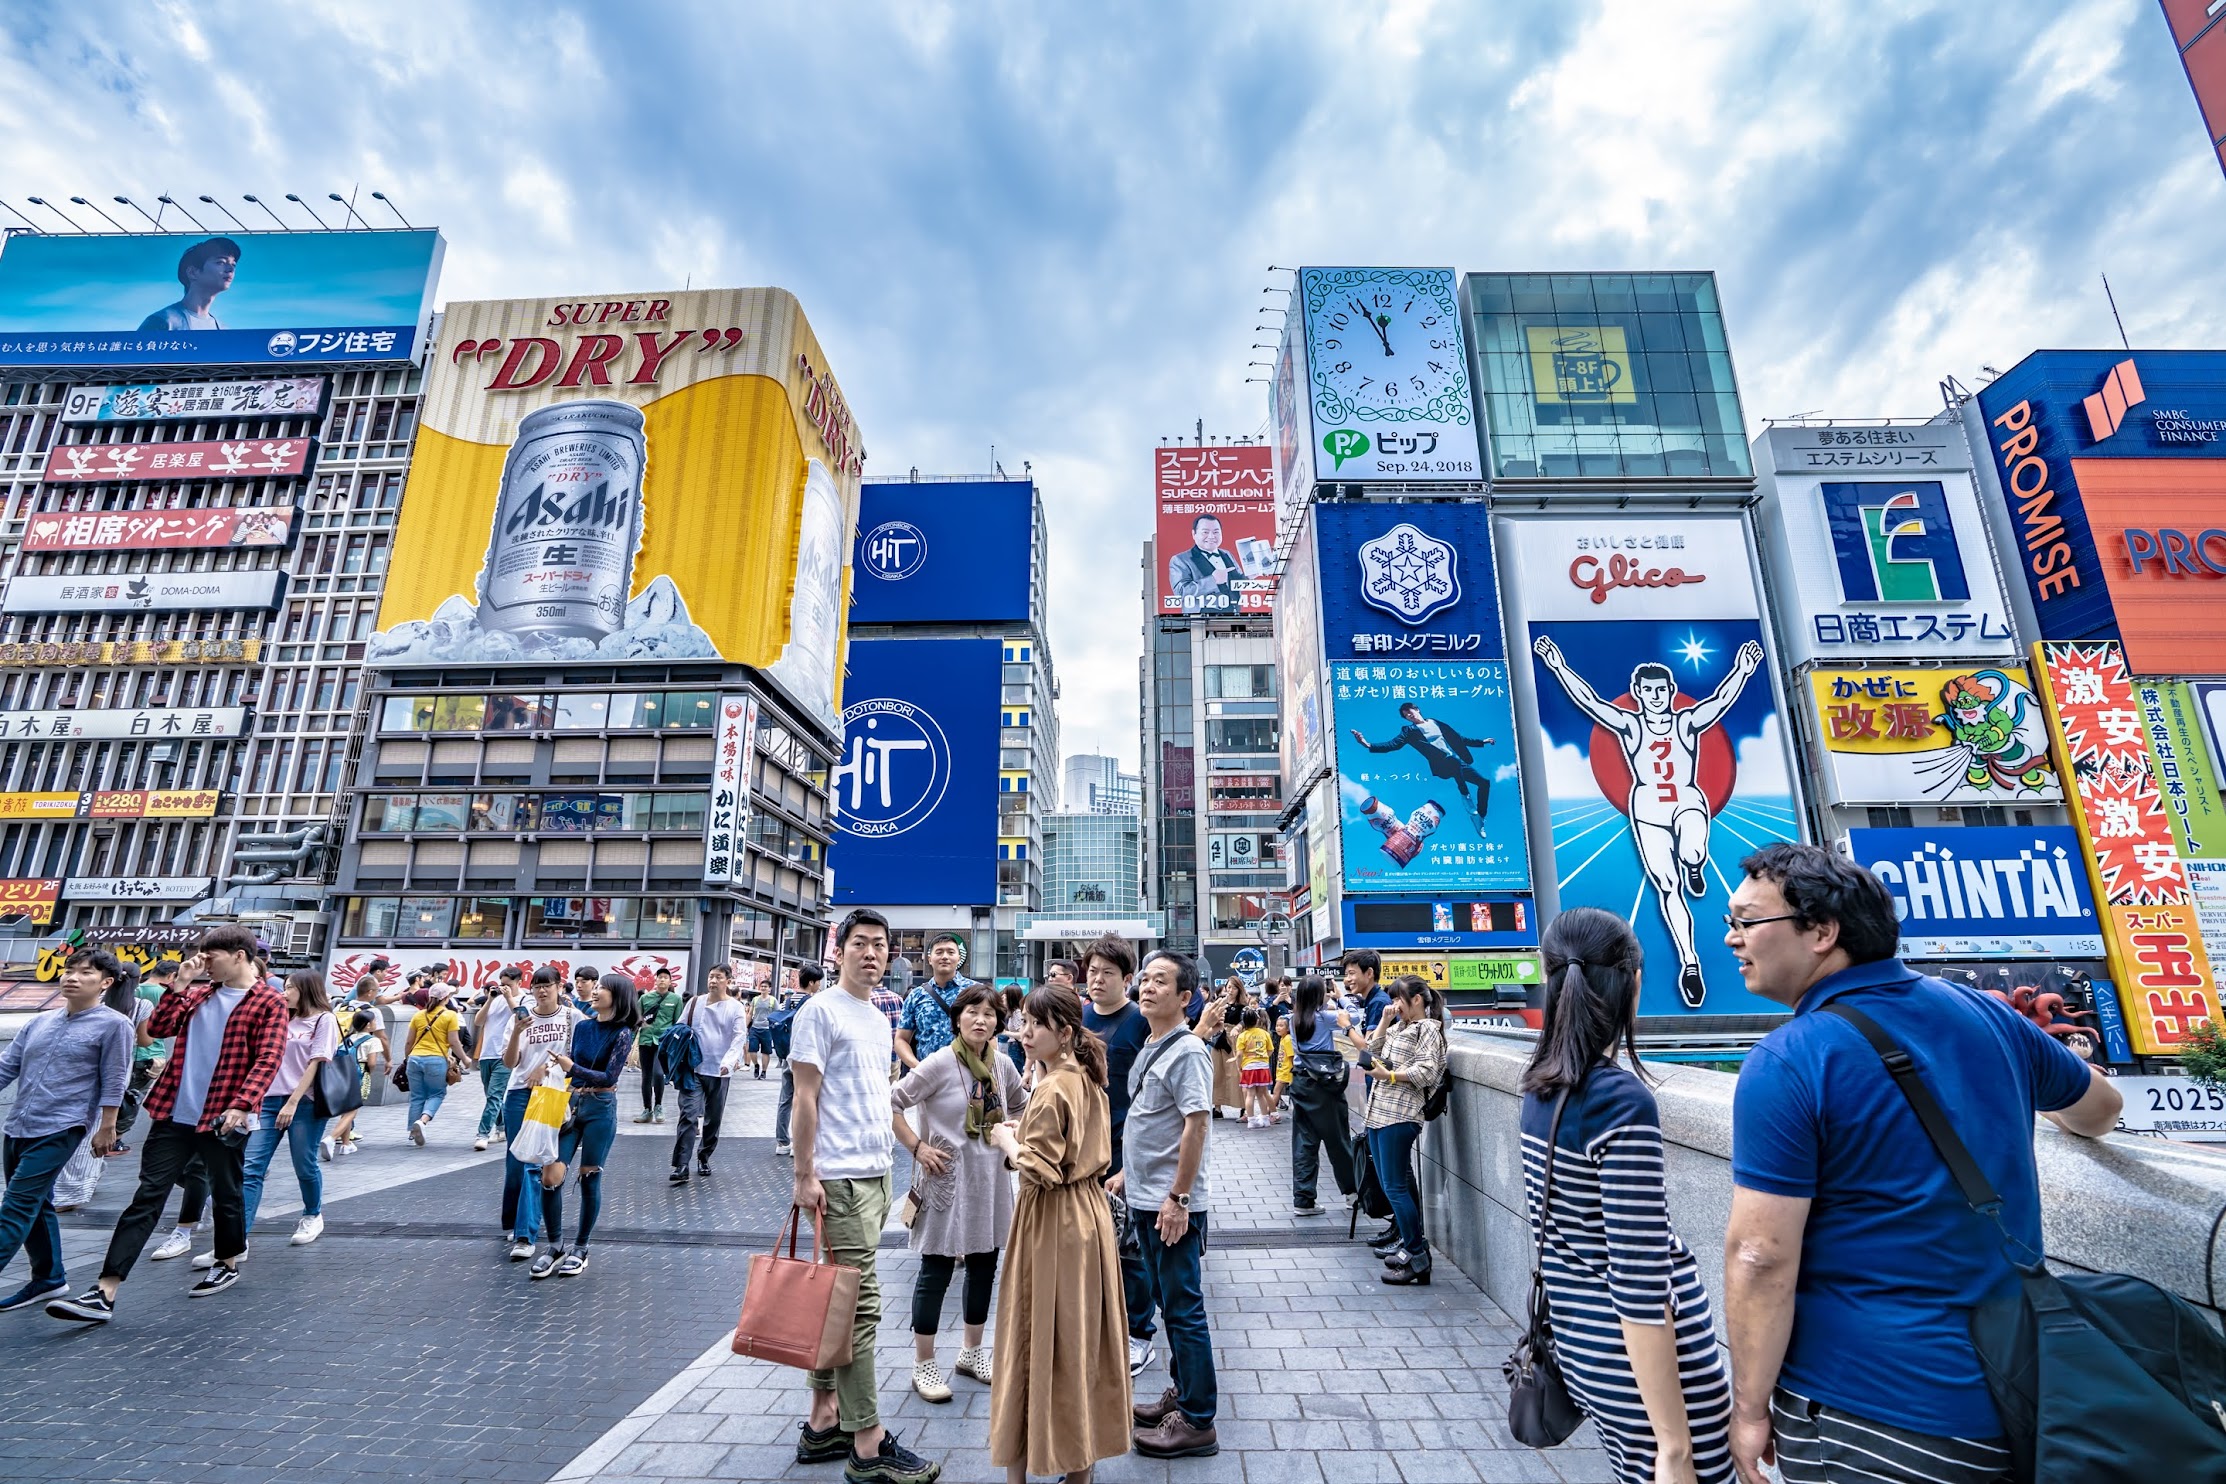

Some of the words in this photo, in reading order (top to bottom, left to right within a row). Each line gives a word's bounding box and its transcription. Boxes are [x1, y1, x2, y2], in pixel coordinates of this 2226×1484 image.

[1371, 294, 1392, 308] 12
[1404, 301, 1413, 313] 1
[547, 299, 670, 328] SUPER
[1328, 312, 1349, 331] 10
[1420, 316, 1436, 330] 2
[1, 340, 200, 354] む人を思う気持ちは誰にも負けない。
[298, 331, 397, 354] フジ住宅
[1325, 339, 1342, 350] 9
[1429, 339, 1448, 350] 3
[1335, 361, 1352, 374] 8
[1427, 360, 1443, 374] 4
[1557, 360, 1597, 376] 7-8F
[1358, 376, 1375, 390] 7
[1385, 381, 1398, 397] 6
[1409, 375, 1425, 391] 5
[1558, 377, 1604, 393] 頭上!
[171, 387, 205, 400] 全室個室
[210, 385, 242, 398] 全160席
[69, 394, 98, 416] 9F
[182, 398, 224, 412] 居酒屋
[822, 371, 850, 431] SUPER
[2152, 409, 2188, 420] SMBC
[1376, 431, 1439, 455] ピップ
[1818, 430, 1915, 445] 夢ある住まい
[2161, 430, 2219, 442] FINANCE
[54, 446, 144, 479] 笑笑
[150, 452, 204, 469] 居楽屋
[208, 441, 298, 475] 笑笑
[530, 454, 551, 474] ASAHI
[553, 442, 598, 456] BREWERIES
[598, 448, 621, 471] LIMITED
[1161, 450, 1238, 468] スーパー
[1807, 450, 1938, 466] エステムシリーズ
[1376, 460, 1408, 475] Sep.
[1410, 460, 1434, 474] 24,
[1436, 460, 1473, 473] 2018
[1161, 469, 1275, 486] ミリオンヘア
[1161, 489, 1208, 499] SUPER
[1212, 488, 1263, 498] MILLION
[1994, 400, 2081, 601] PROMISE
[506, 479, 630, 535] Asahi
[1162, 503, 1276, 514] 薄毛部分のボリュームア
[62, 515, 231, 547] 相席ダイニング
[1577, 535, 1685, 549] おいしさと健康
[542, 544, 579, 566] 生
[522, 570, 594, 584] スーパードライ
[60, 586, 104, 600] 居酒家
[160, 586, 221, 596] DOMA-DOMA
[538, 582, 571, 594] 生ビール
[1183, 594, 1273, 609] 0120-494
[535, 606, 567, 618] 350ml
[1814, 613, 2012, 644] 日商エステム
[1351, 633, 1481, 653] 雪印メグミルク
[1336, 666, 1503, 681] 道頓堀のおいしいものと
[1831, 676, 1918, 699] かぜに
[845, 700, 916, 720] DOTONBORI
[2060, 666, 2144, 746] 激安
[129, 711, 214, 735] 白木屋
[1825, 702, 1937, 740] 改源
[2167, 688, 2212, 816] 不動産再生のスペシャリスト
[1360, 772, 1428, 782] 軽々、つづく。
[1648, 737, 1679, 802] グリコ
[2140, 688, 2202, 854] 株式会社日本リート
[0, 797, 29, 813] 貴族
[34, 801, 74, 809] TORIKIZOKU
[79, 792, 93, 815] 3F
[1214, 800, 1224, 810] 5F
[851, 821, 899, 835] OSAKA
[2095, 797, 2184, 882] 激安
[1430, 843, 1504, 852] ガセリ菌SP株が
[1431, 854, 1510, 866] 内臓脂肪を減らす
[2189, 873, 2211, 881] Real
[0, 883, 42, 899] どり
[42, 880, 61, 891] 2F
[165, 885, 197, 893] BOTEJYU
[1080, 883, 1099, 891] なんば
[2192, 882, 2220, 891] Estate
[2126, 912, 2184, 930] スーパー
[85, 928, 201, 942] ハンバーグレストラン
[1060, 929, 1081, 937] EBISU
[1416, 935, 1462, 944] 雪印メグミルク
[2069, 940, 2097, 951] 11:56
[1315, 968, 1341, 976] Toilets
[1478, 962, 1515, 980] ピタットハウス
[2082, 980, 2093, 1004] 2F
[2132, 933, 2211, 1046] 玉出
[525, 1023, 567, 1038] RESOLVE
[1451, 1017, 1514, 1029] TERIA
[529, 1032, 564, 1045] DECIDE
[2146, 1087, 2224, 1111] 2025
